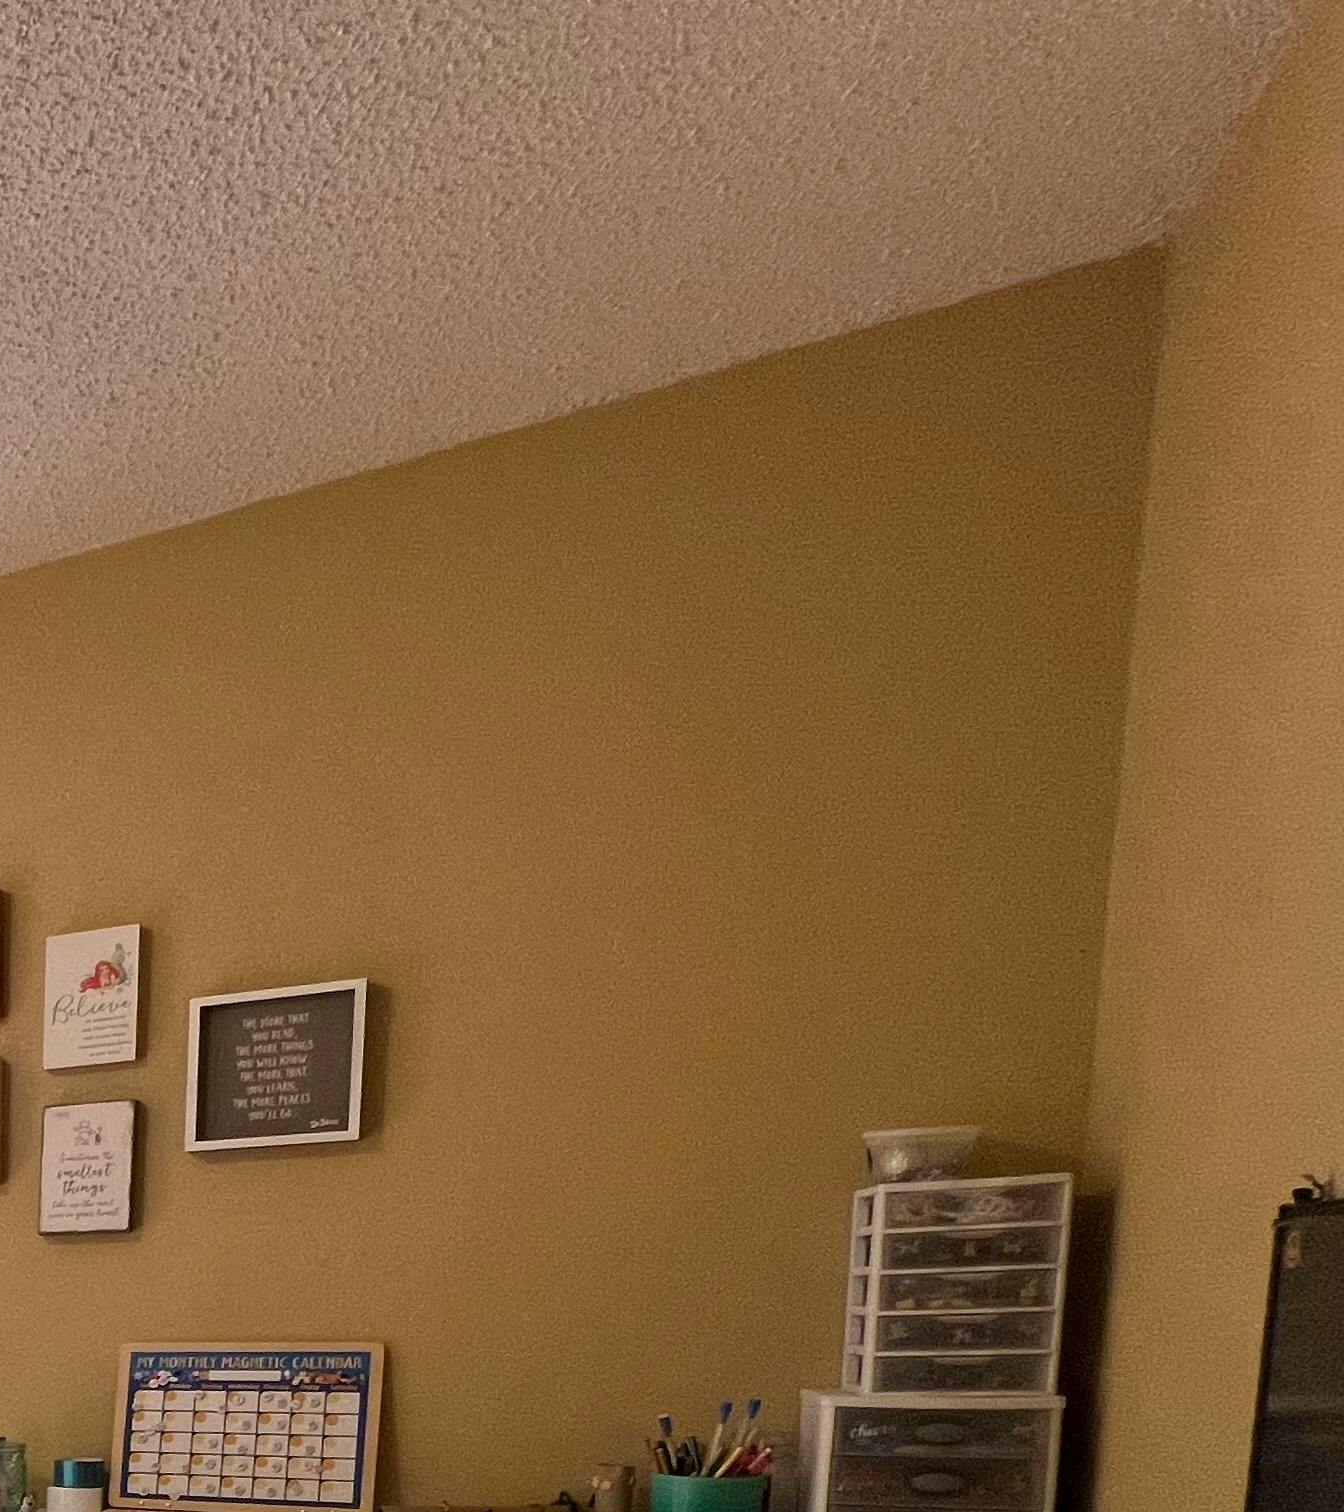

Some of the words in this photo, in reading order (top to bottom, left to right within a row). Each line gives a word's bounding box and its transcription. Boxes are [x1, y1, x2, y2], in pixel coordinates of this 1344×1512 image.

[51, 994, 132, 1026] Believe
[57, 1163, 114, 1179] smallest
[63, 1180, 108, 1197] things
[137, 1357, 156, 1368] MY
[159, 1357, 216, 1368] MONTHLY
[221, 1357, 285, 1369] MAGNETIC
[292, 1357, 362, 1369] CALENDAR
